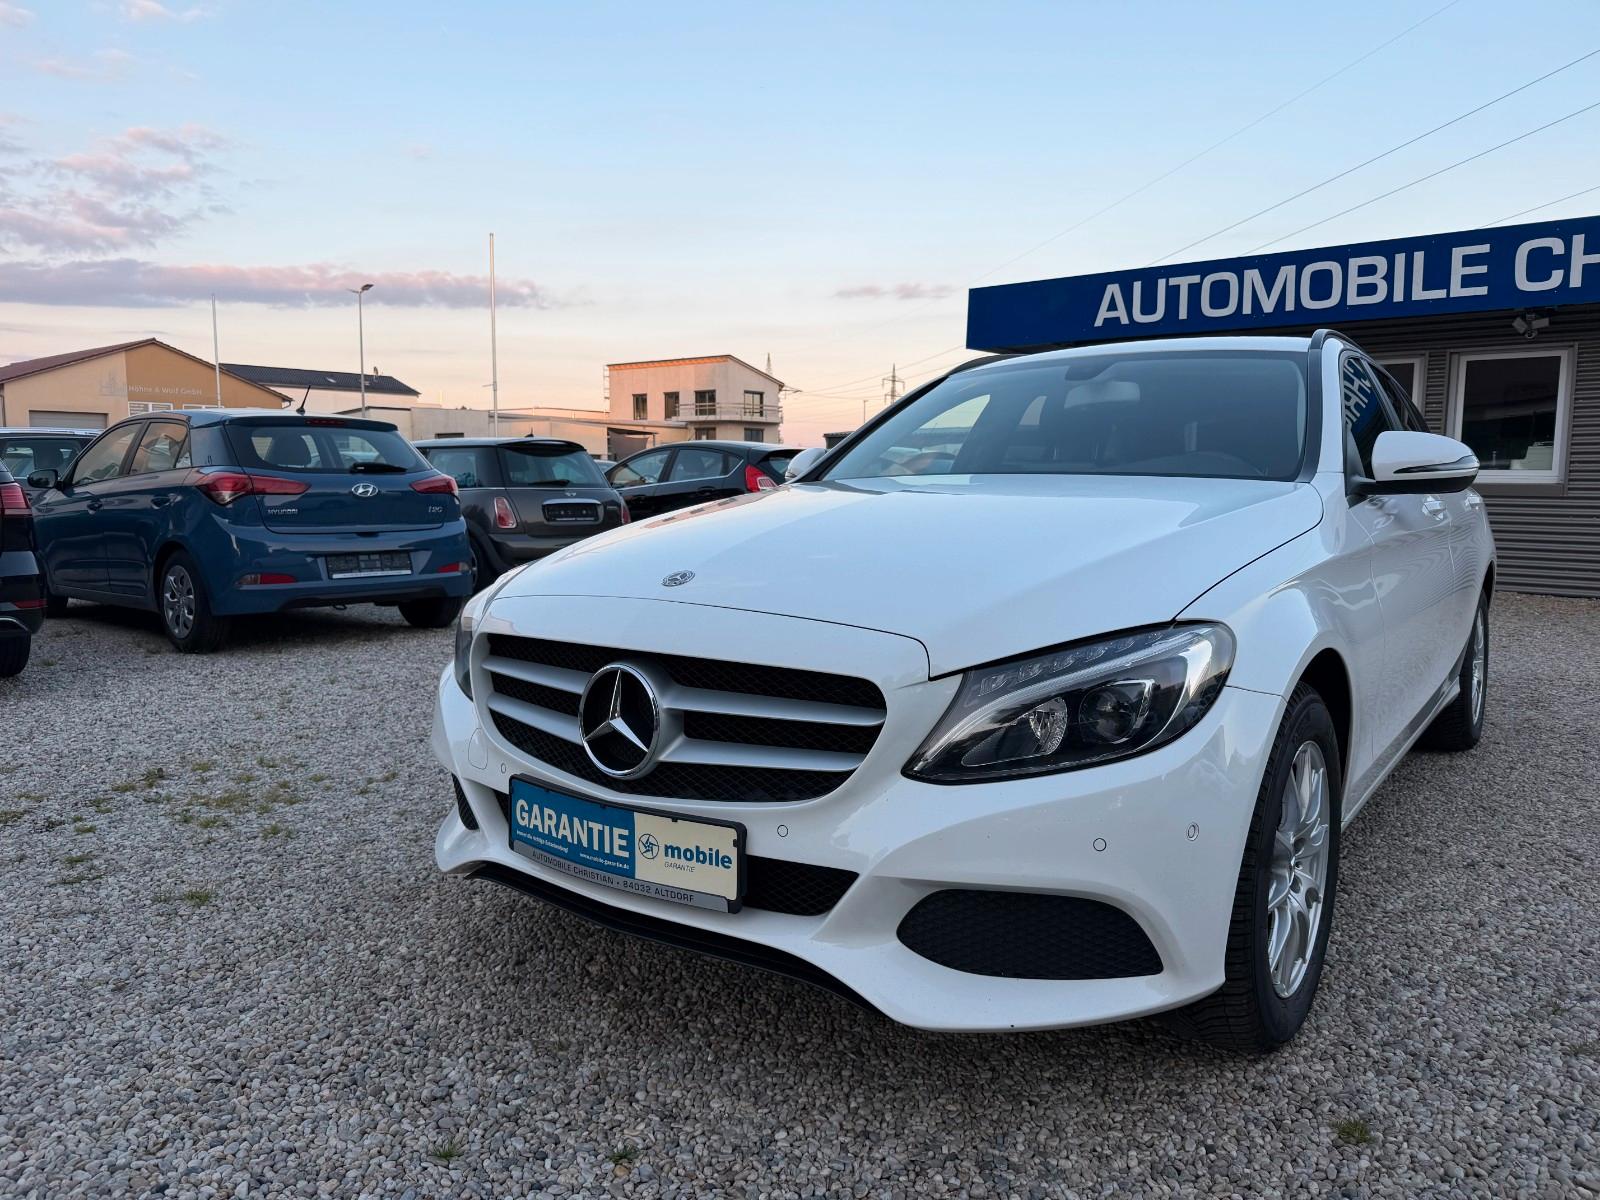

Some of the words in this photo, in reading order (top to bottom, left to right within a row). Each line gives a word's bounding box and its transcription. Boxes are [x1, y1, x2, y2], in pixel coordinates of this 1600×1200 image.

[1093, 243, 1491, 328] AUTOMOBILE
[180, 387, 202, 396] GmbH
[515, 798, 630, 859] GARANTIE
[664, 844, 733, 869] mobile
[664, 861, 696, 873] GARANTIE
[532, 850, 573, 872] AUTOMOBILE
[573, 866, 615, 886] CHRISTIAN
[623, 880, 652, 894] 84032
[654, 886, 695, 904] ALTDORF
